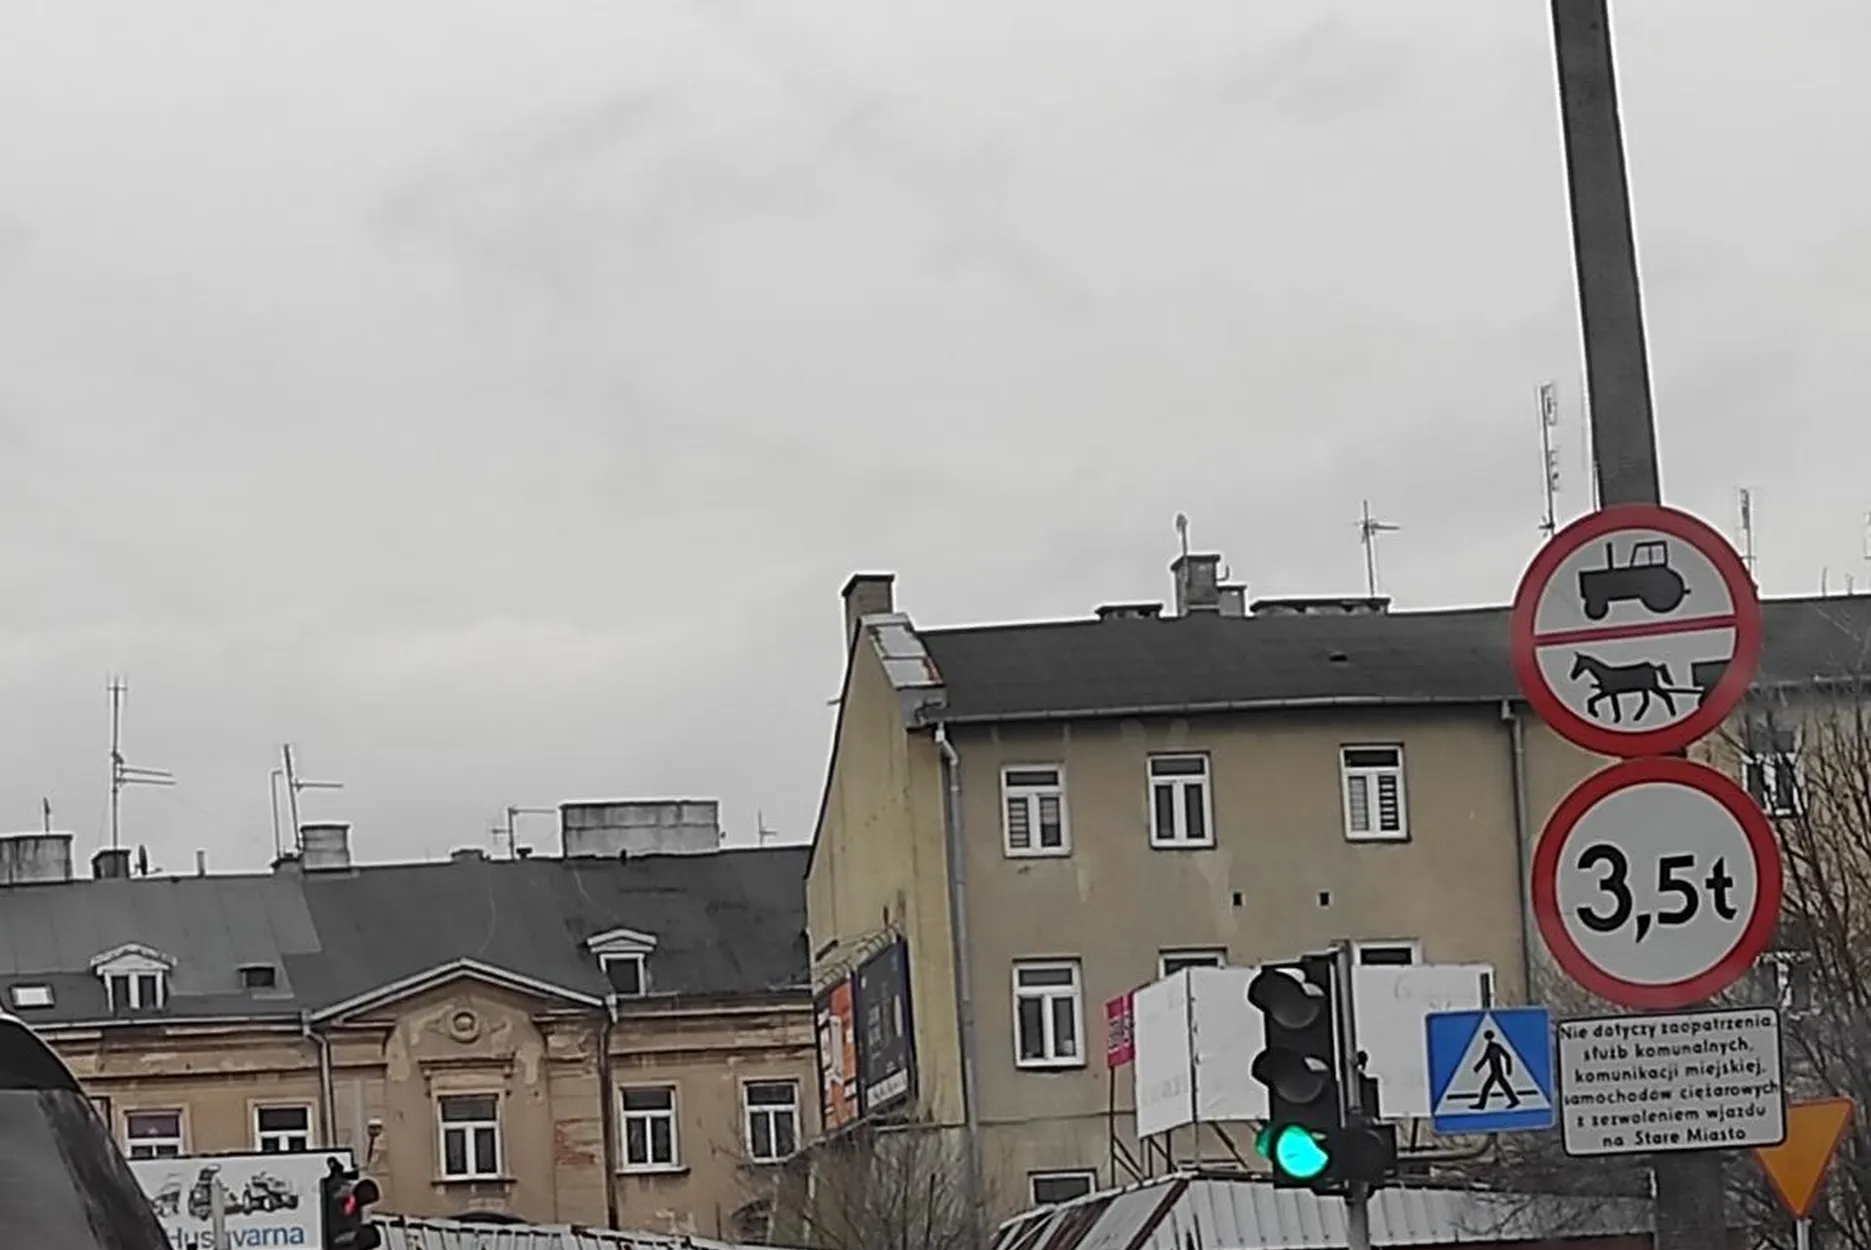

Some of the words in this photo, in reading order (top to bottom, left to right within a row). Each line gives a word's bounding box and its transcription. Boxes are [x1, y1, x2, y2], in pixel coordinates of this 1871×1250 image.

[1576, 843, 1738, 944] 3,5t
[1560, 1025, 1588, 1040] Nie
[1593, 1023, 1656, 1040] dotyczy
[1575, 1064, 1679, 1083] komunikacji
[1592, 1107, 1700, 1127] zezwoleniem
[1706, 1103, 1767, 1122] wjazdu
[1602, 1135, 1624, 1147] na
[1635, 1130, 1680, 1146] Stare
[1687, 1127, 1746, 1143] Miasto
